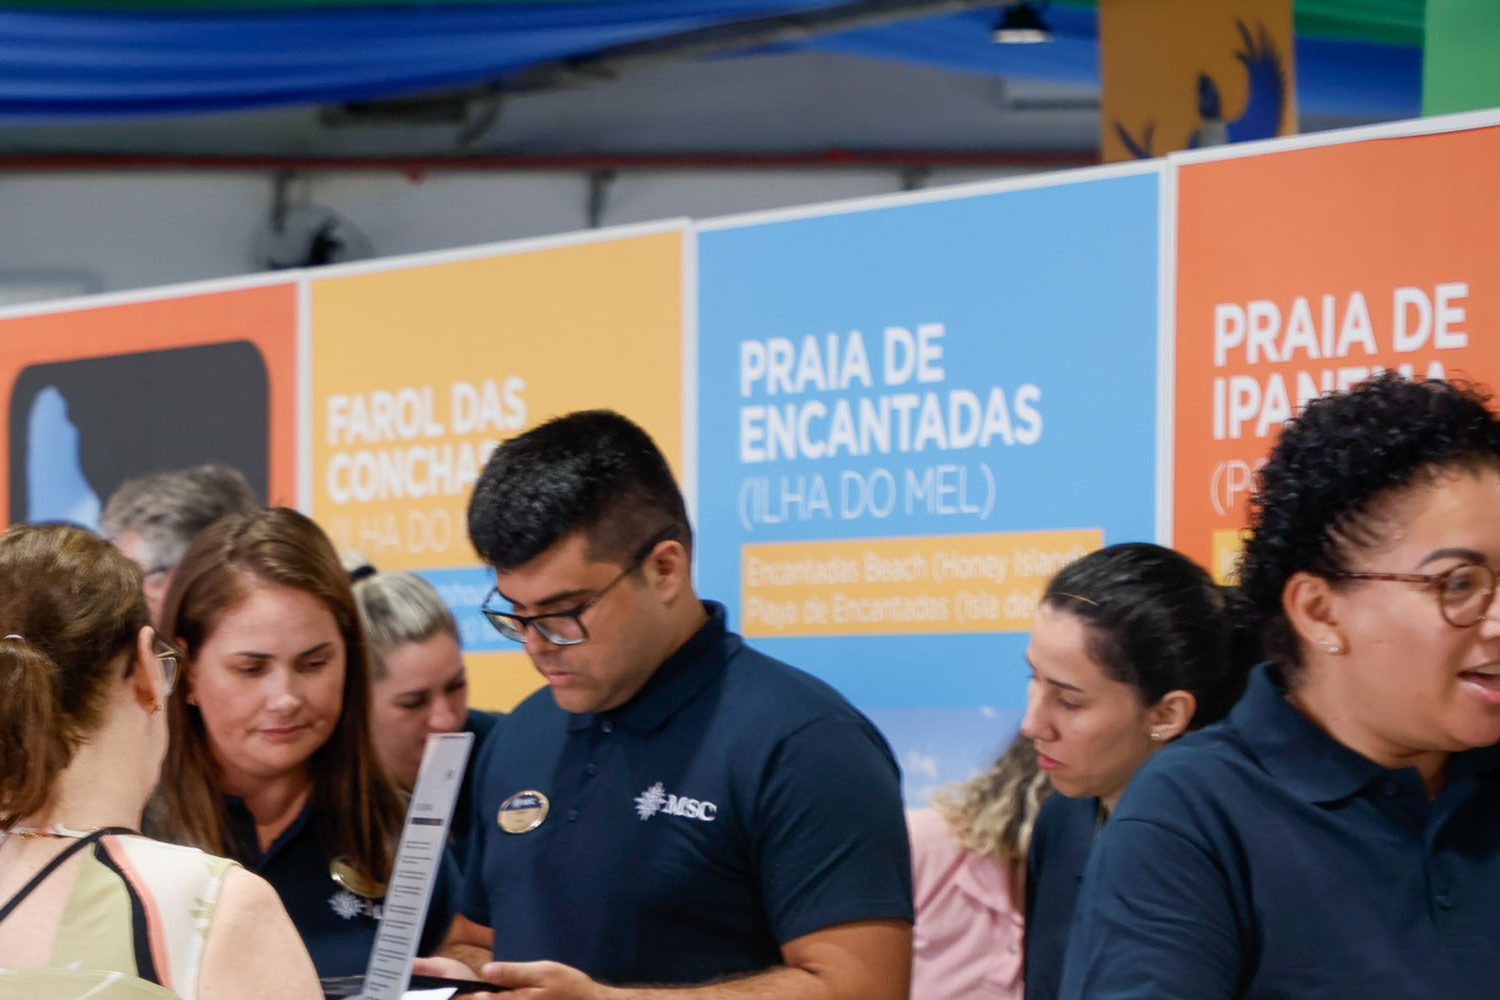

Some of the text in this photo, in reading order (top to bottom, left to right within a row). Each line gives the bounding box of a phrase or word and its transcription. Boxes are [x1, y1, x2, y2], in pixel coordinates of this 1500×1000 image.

[1214, 282, 1469, 366] PRAIA DE
[741, 323, 945, 398] PRAIA DE
[326, 375, 528, 446] FAROL DAS
[740, 384, 1043, 463] ENCANTADAS
[739, 463, 996, 531] (ILHA DO MEL)
[864, 551, 928, 584] Beach
[662, 793, 718, 822] MSC
